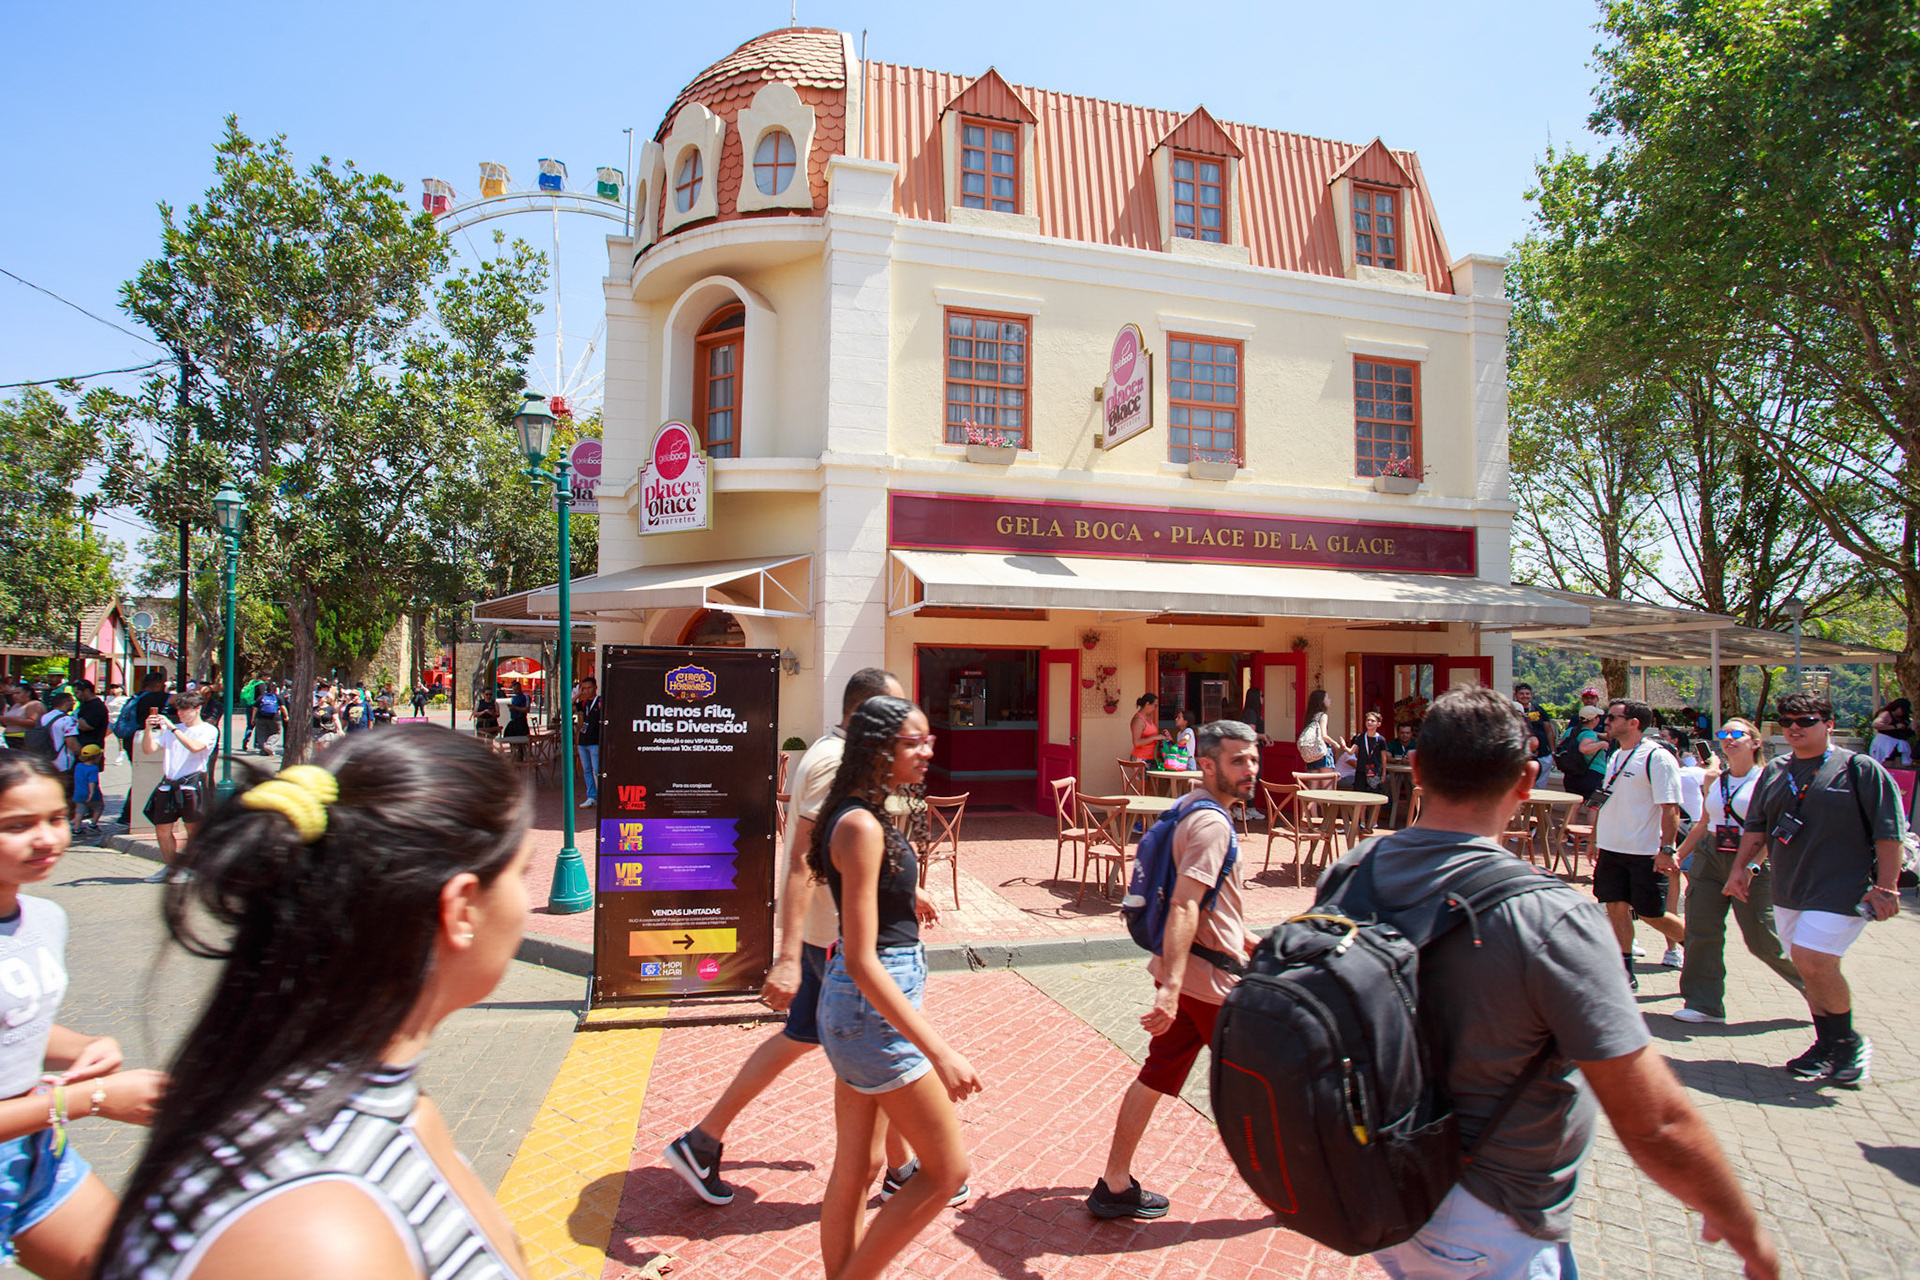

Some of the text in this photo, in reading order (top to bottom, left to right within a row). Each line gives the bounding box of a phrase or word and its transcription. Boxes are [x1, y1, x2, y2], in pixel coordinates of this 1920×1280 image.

[575, 456, 602, 465] gelaboc
[658, 450, 687, 465] gelaboca
[570, 473, 601, 490] lac
[645, 477, 692, 509] place
[648, 494, 697, 526] glace
[661, 516, 696, 525] sorvetes
[996, 516, 1396, 556] GELA BOCA PLACE DE LA GLACE
[675, 673, 706, 683] CIRCO
[669, 681, 711, 691] HORRORES
[703, 704, 736, 720] Fila,
[676, 719, 748, 734] Diversão!
[617, 785, 647, 802] VIP
[619, 823, 643, 837] VIP
[614, 862, 643, 878] VIP
[651, 907, 721, 916] VENDAS LIMITADAS
